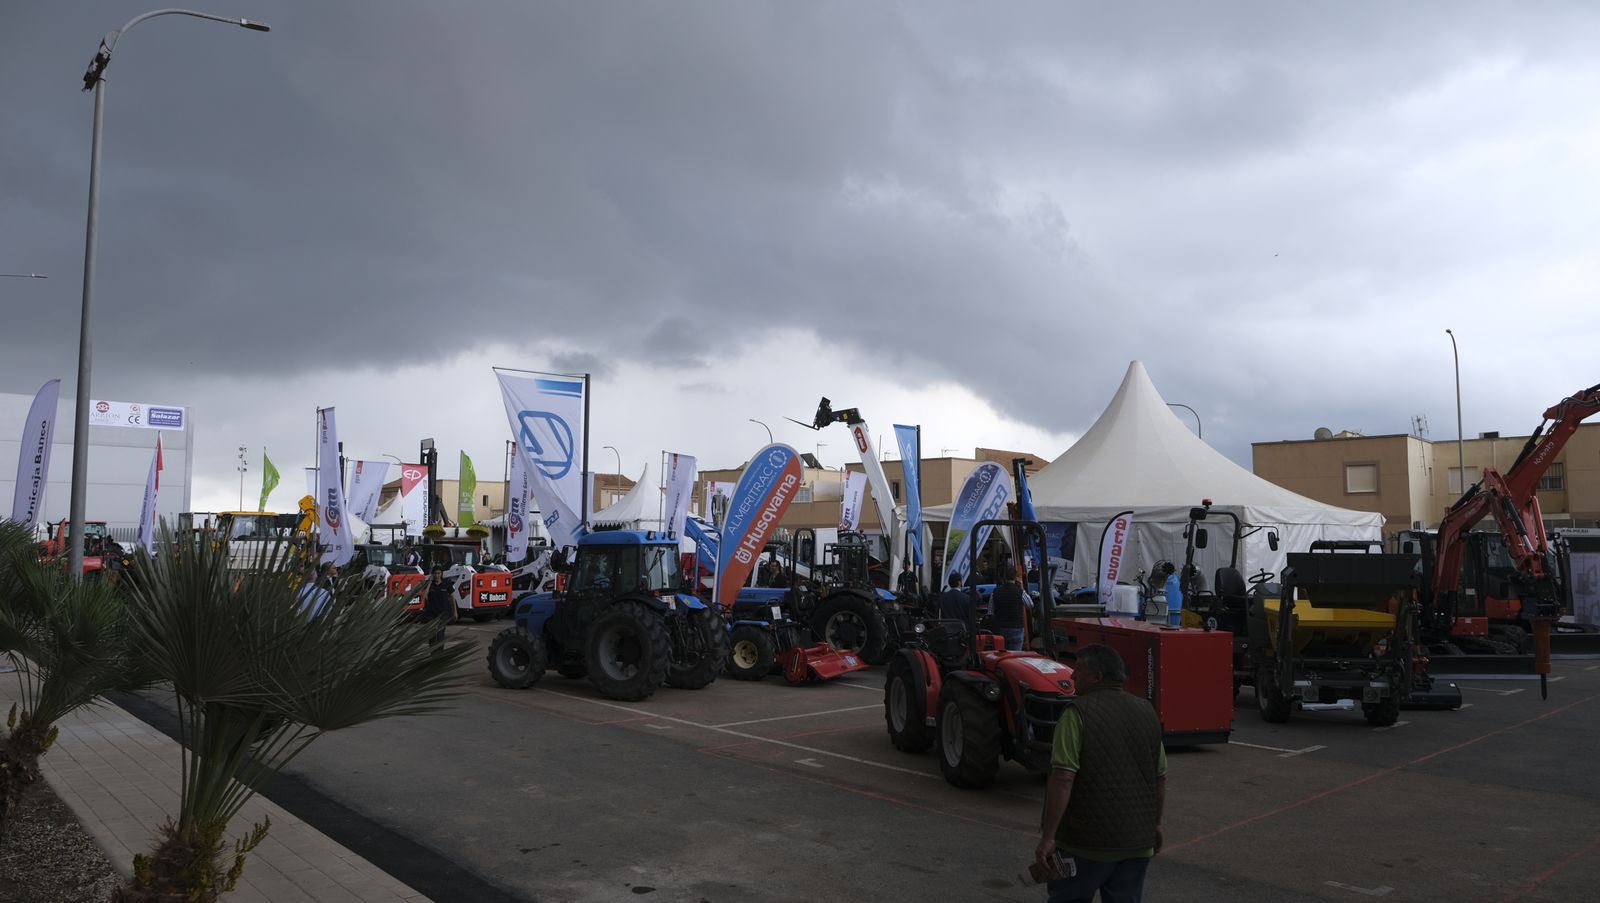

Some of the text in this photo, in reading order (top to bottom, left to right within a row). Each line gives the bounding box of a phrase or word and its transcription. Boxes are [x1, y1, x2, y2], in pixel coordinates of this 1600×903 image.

[26, 420, 47, 523] Unicaja Banco
[728, 466, 773, 536] ALMERITRAC
[743, 473, 798, 550] Husqvarna
[489, 592, 507, 602] Bobcat
